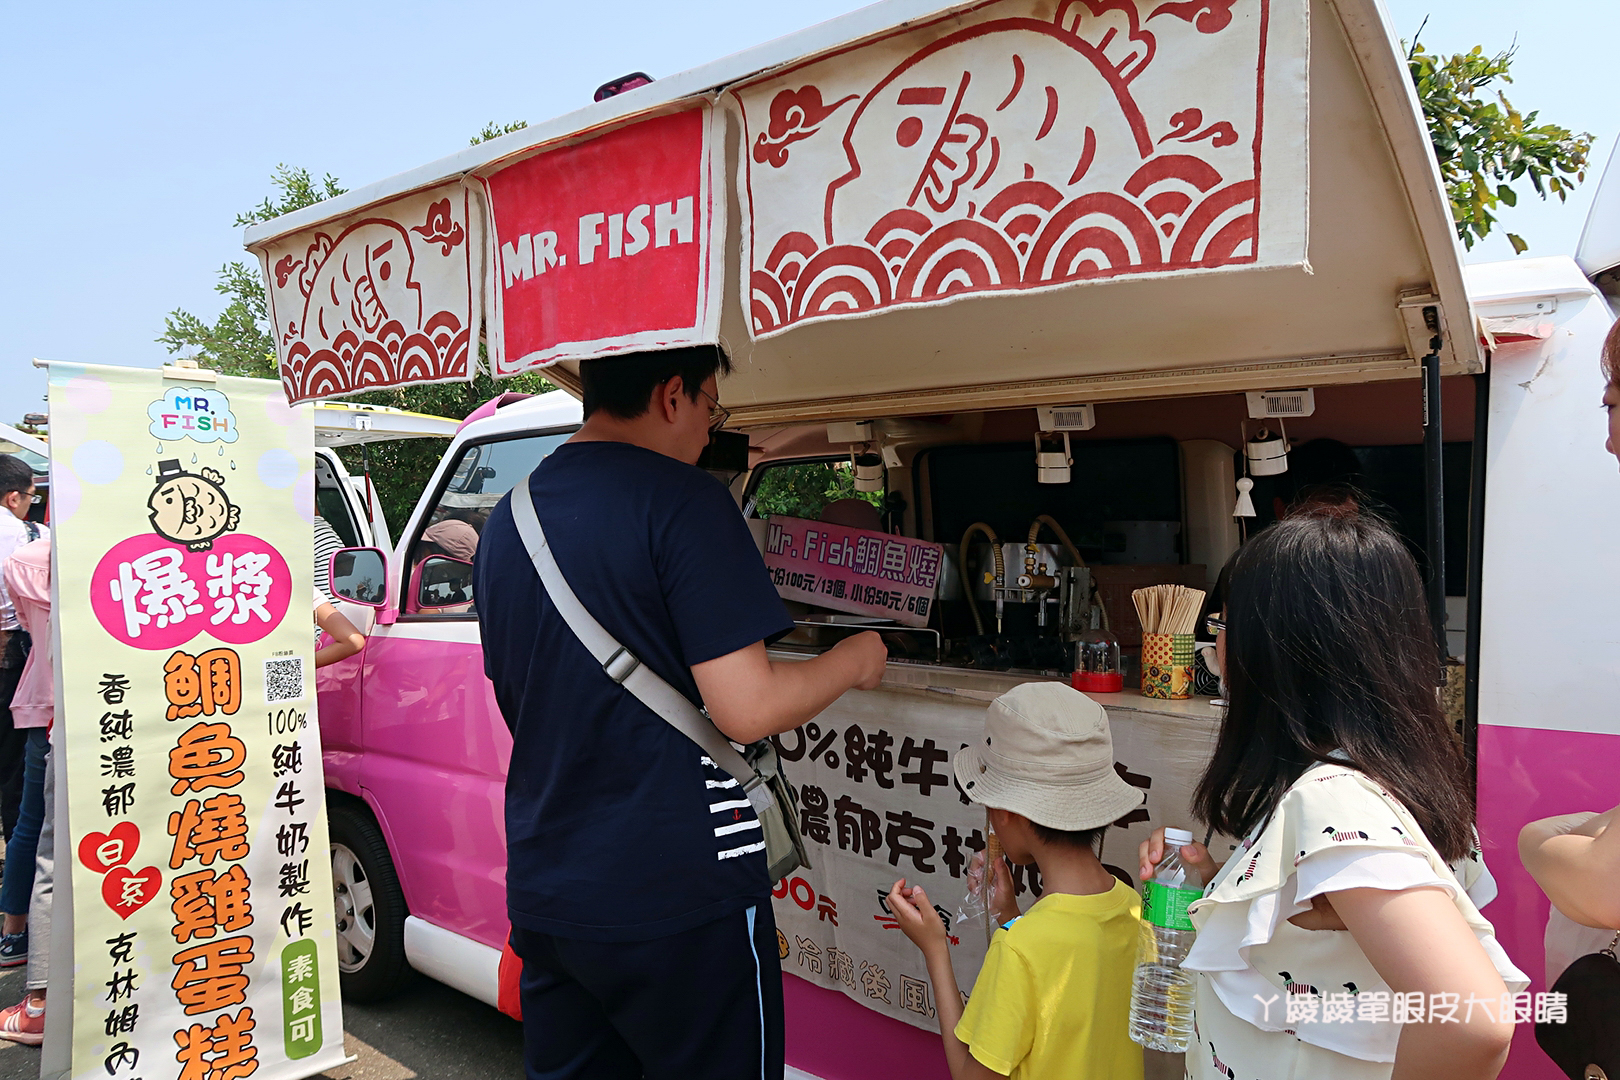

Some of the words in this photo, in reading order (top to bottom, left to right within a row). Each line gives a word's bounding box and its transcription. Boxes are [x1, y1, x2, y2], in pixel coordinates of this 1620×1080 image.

[501, 231, 567, 289] MR.
[578, 196, 694, 265] FISH
[161, 414, 229, 432] FISH
[175, 396, 216, 416] MR.
[110, 548, 273, 638] 爆漿
[97, 673, 136, 817] 香純濃郁
[96, 839, 149, 907] 日系
[163, 648, 260, 1080] 鯛魚燒雞蛋糕
[104, 932, 141, 1080] 克林姆內
[287, 954, 315, 1044] 素食可
[795, 934, 969, 1018] 冷藏後風
